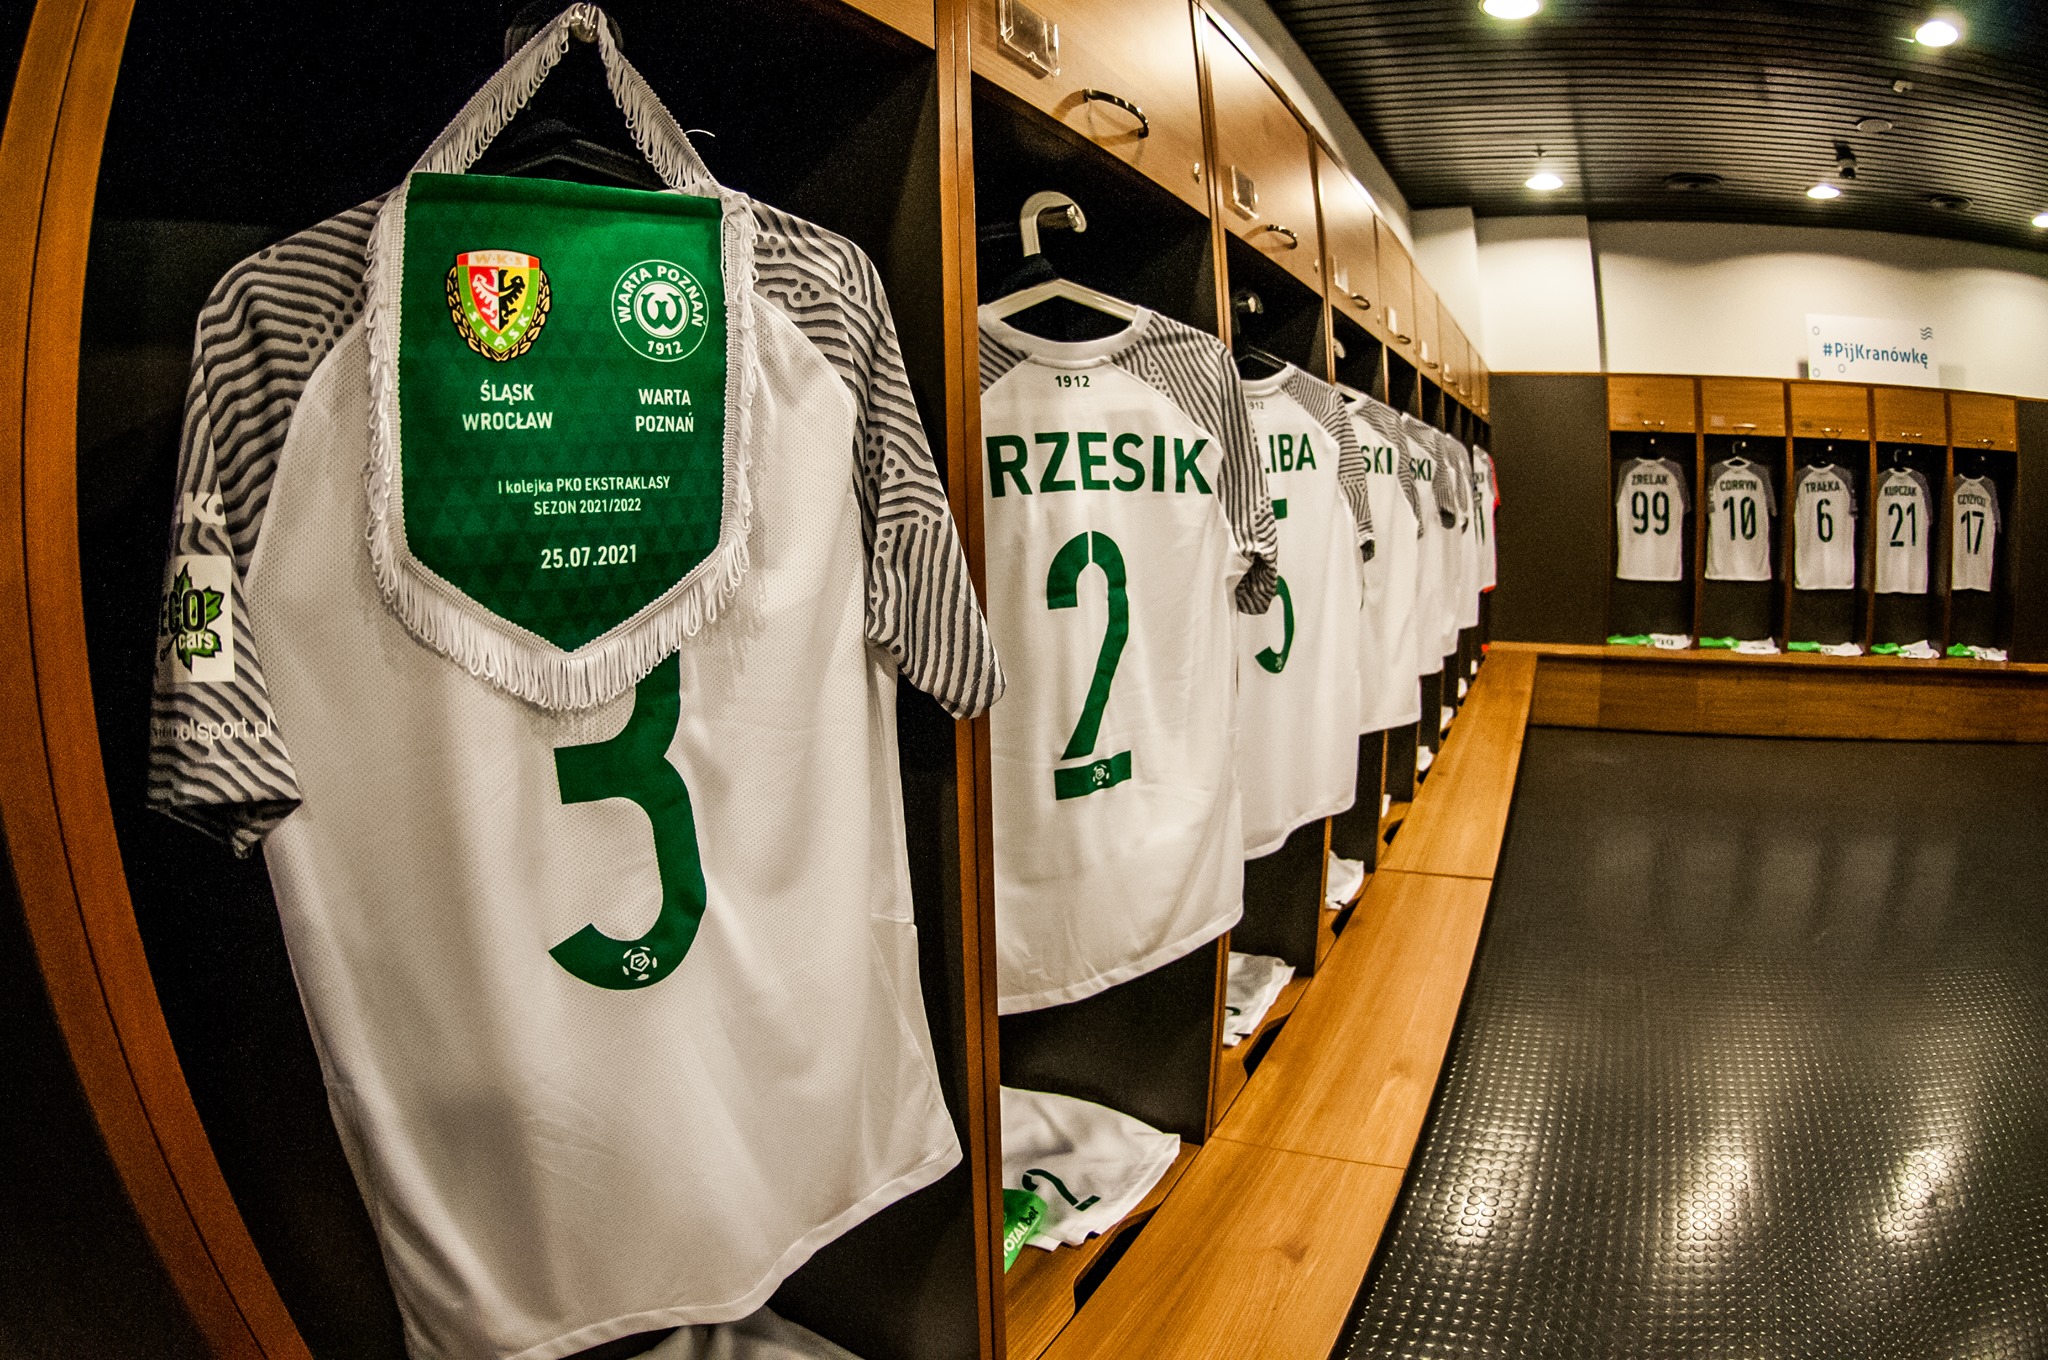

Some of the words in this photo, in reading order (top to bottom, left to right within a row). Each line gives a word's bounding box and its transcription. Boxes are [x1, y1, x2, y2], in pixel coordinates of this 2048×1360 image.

[617, 267, 653, 324] WARTA
[647, 340, 684, 355] 1912
[1823, 342, 1929, 369] #PijKranówkę
[480, 379, 535, 405] ŚLĄSK
[638, 388, 692, 406] WARTA
[1055, 375, 1090, 388] 1912
[462, 411, 553, 431] WROCŁAW
[635, 411, 694, 433] POZNAŃ
[985, 431, 1213, 498] RZESIK
[1264, 433, 1317, 474] IBA
[505, 479, 554, 497] kolejka
[556, 477, 582, 492] PKO
[585, 475, 671, 491] EKSTRAKLASY
[179, 491, 227, 526] KO
[533, 500, 577, 516] SEZON
[579, 497, 642, 514] 2021/2022
[1632, 491, 1669, 535] 99
[1723, 496, 1757, 541] 10
[1816, 498, 1833, 543] 6
[1888, 502, 1917, 547] 21
[1960, 510, 1985, 555] 17
[540, 544, 637, 570] 25.07.2021
[178, 632, 215, 651] cars
[1046, 530, 1132, 801] 2
[548, 649, 707, 990] 3
[1022, 1168, 1101, 1212] 2
